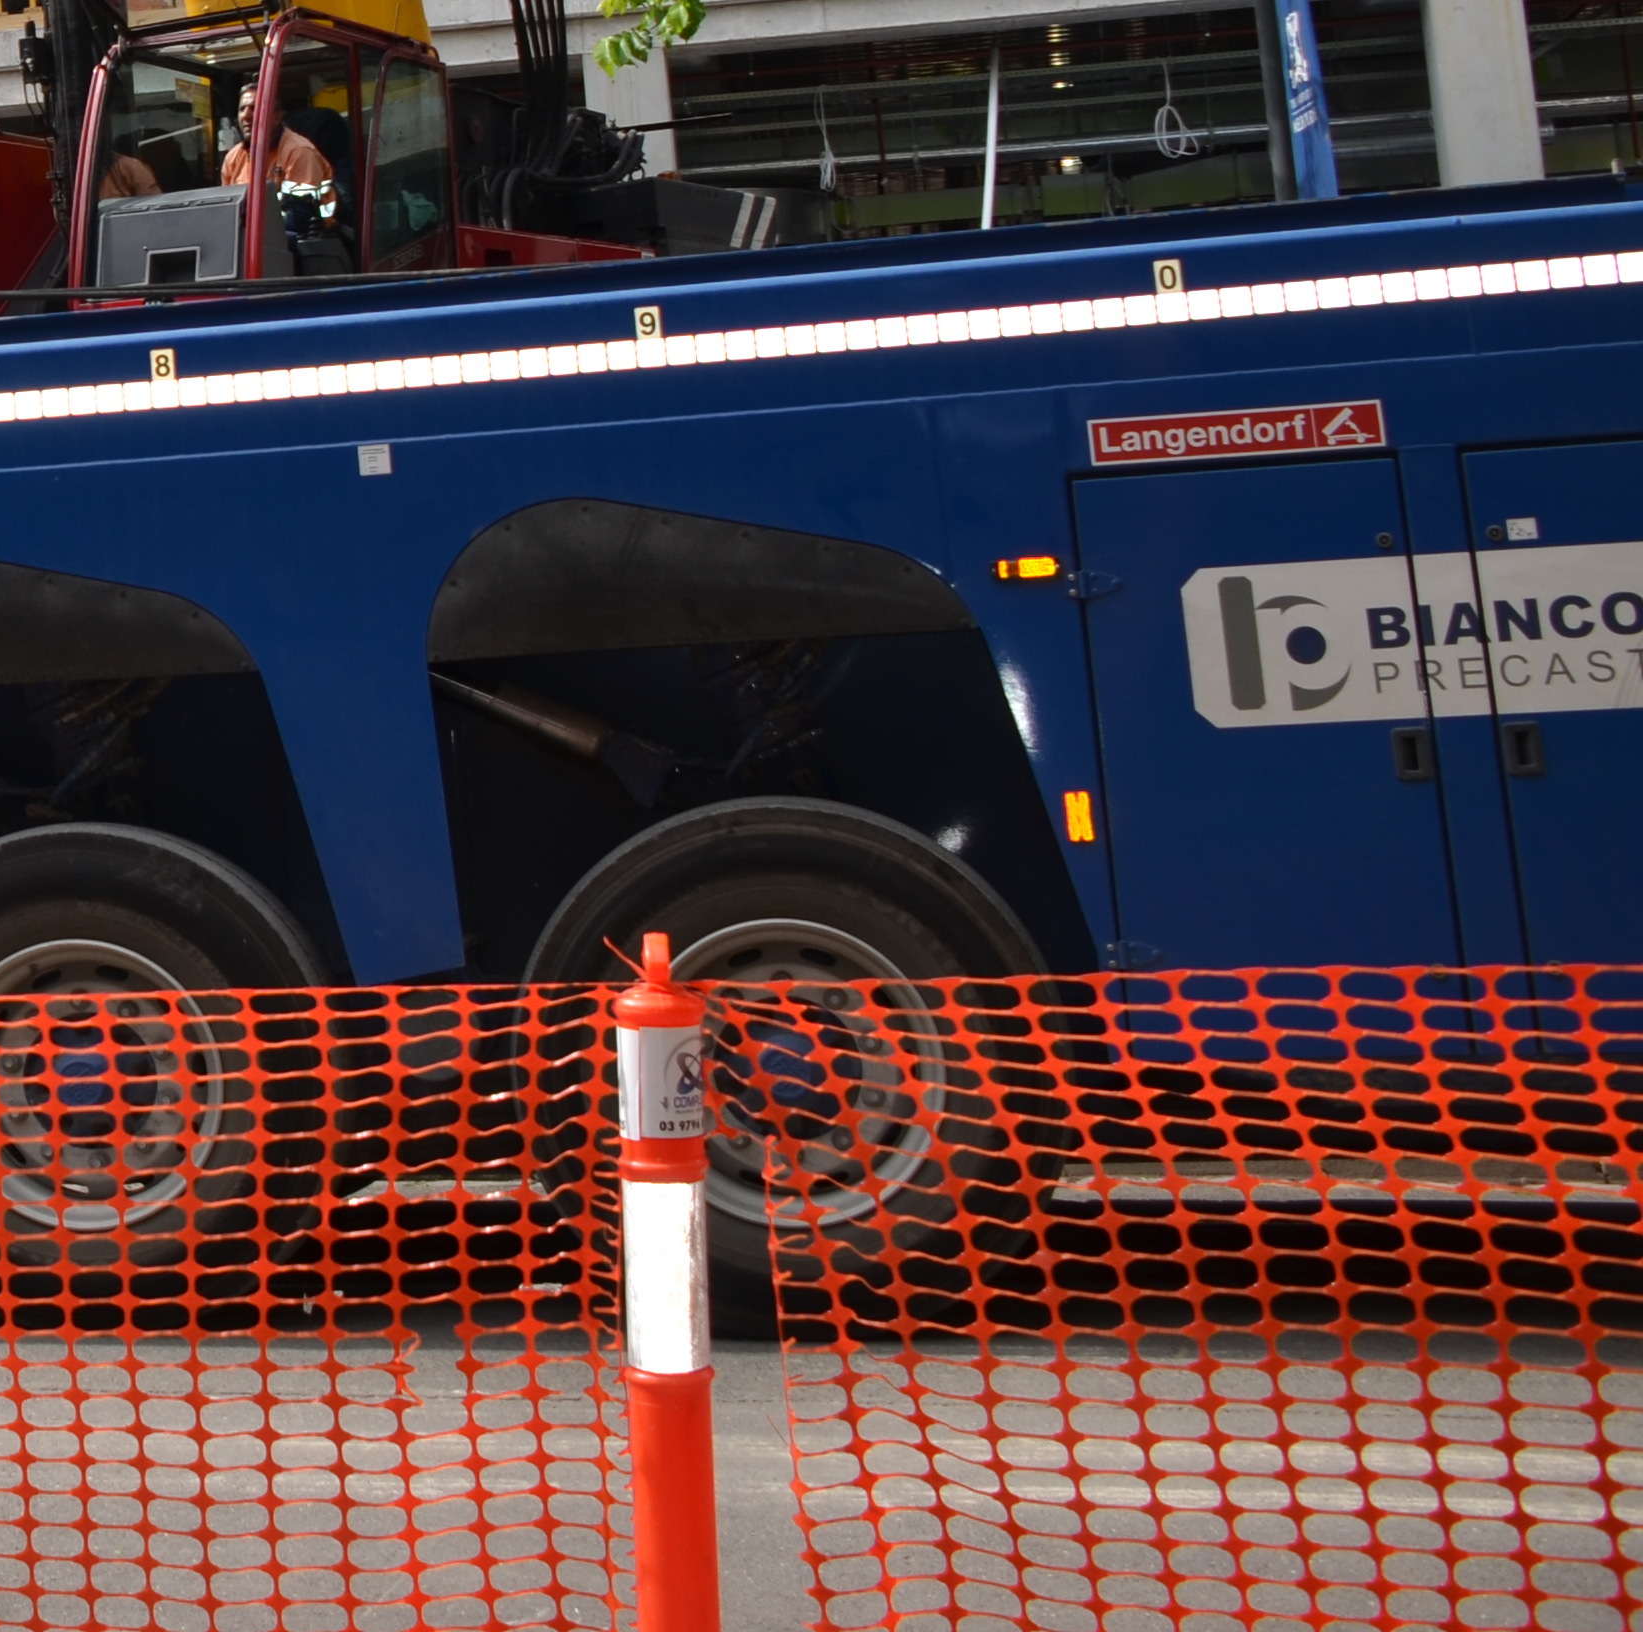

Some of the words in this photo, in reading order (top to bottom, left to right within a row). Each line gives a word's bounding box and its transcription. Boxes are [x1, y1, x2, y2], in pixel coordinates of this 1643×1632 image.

[1159, 265, 1177, 290] 0
[639, 311, 657, 336] 9
[155, 354, 171, 377] 8
[1098, 413, 1307, 455] Langendorf
[1365, 591, 1643, 650] BIANCO
[659, 1120, 675, 1131] 03
